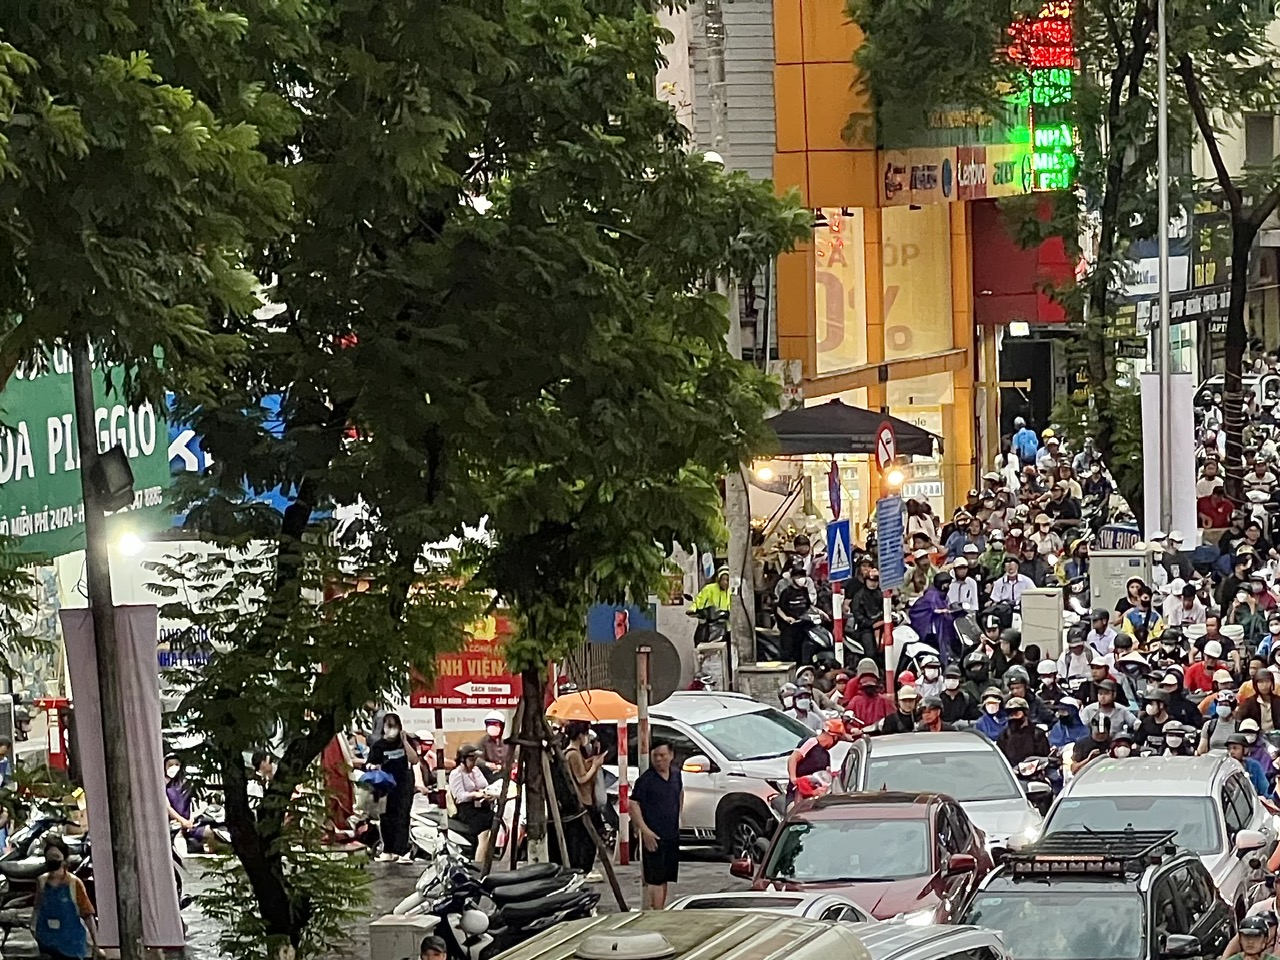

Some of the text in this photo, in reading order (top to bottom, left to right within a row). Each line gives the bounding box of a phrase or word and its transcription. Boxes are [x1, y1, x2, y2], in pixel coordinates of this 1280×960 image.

[958, 159, 986, 186] Lenovo
[1208, 323, 1228, 333] LAPT
[48, 402, 156, 474] PIGGIO
[467, 656, 503, 679] VIỆN
